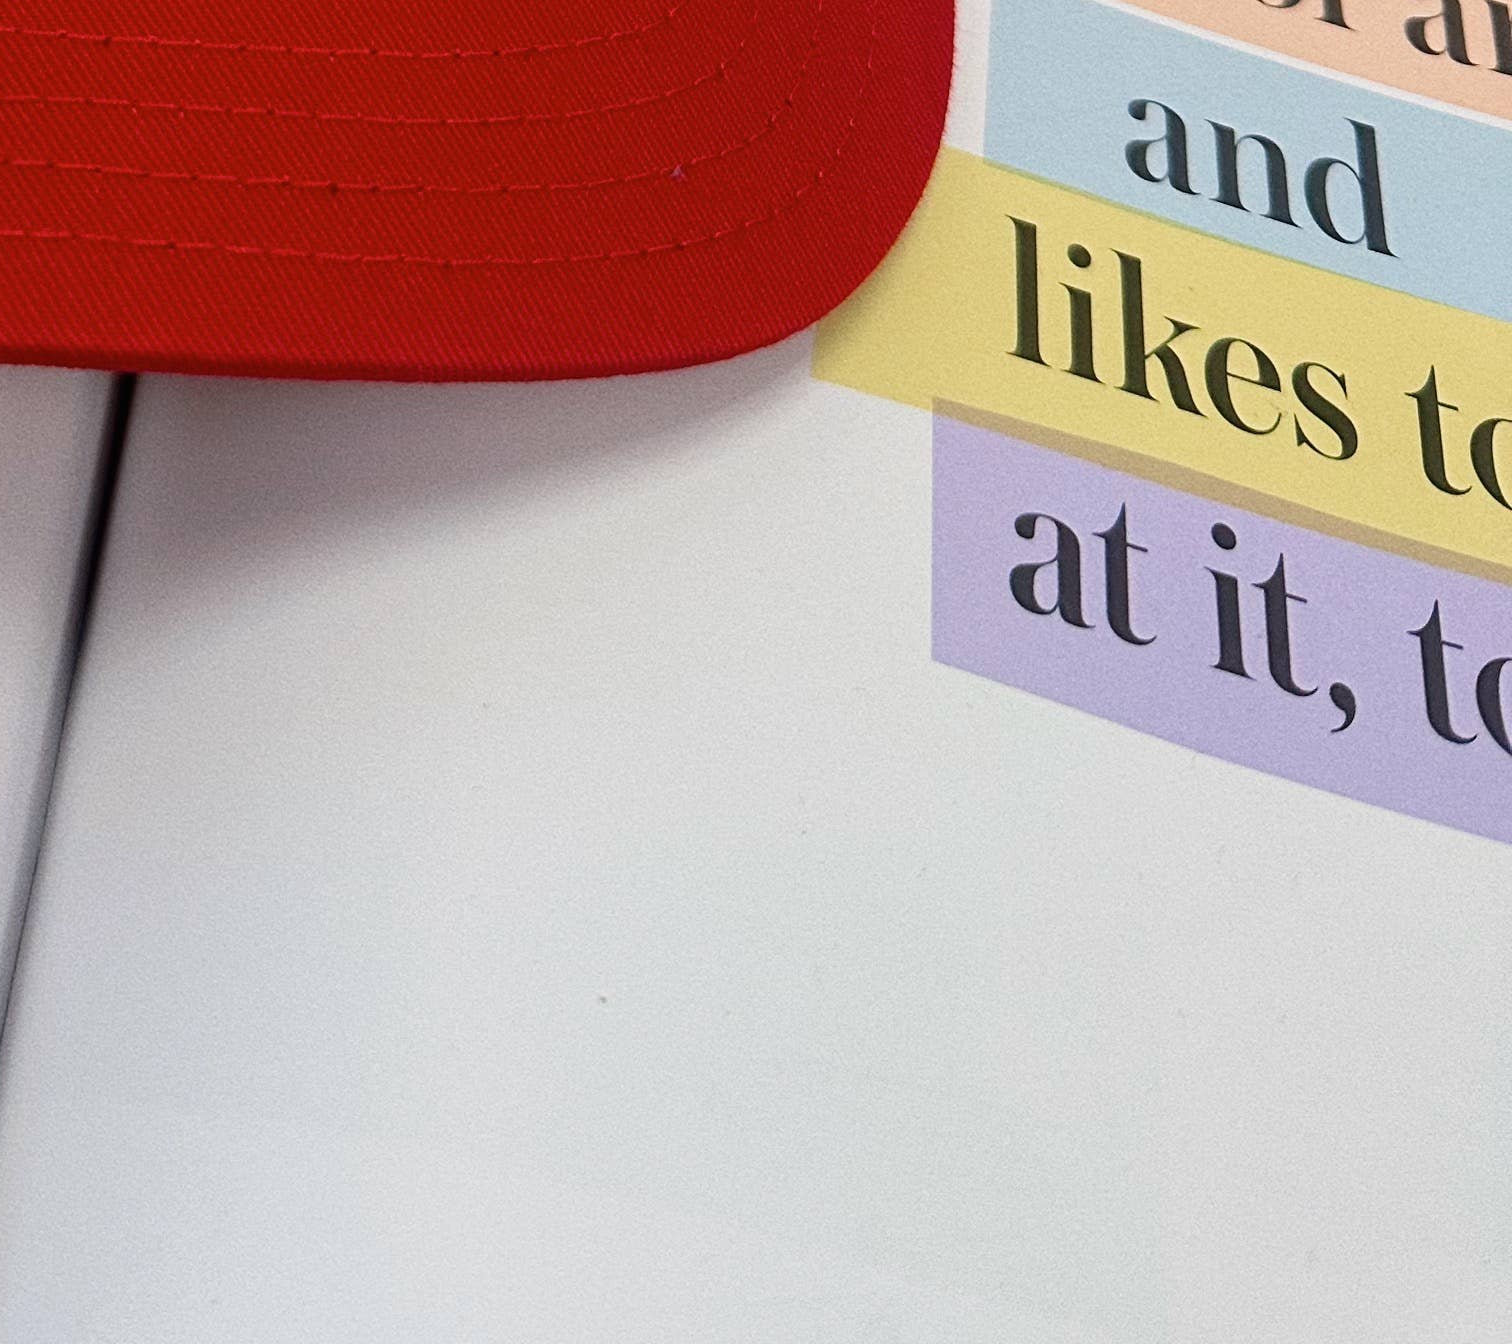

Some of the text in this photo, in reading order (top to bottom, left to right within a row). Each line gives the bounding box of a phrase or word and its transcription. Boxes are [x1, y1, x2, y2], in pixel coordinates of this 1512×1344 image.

[1125, 98, 1399, 258] and
[1007, 215, 1359, 461] likes
[1009, 502, 1157, 646] at
[1204, 522, 1357, 734] it,
